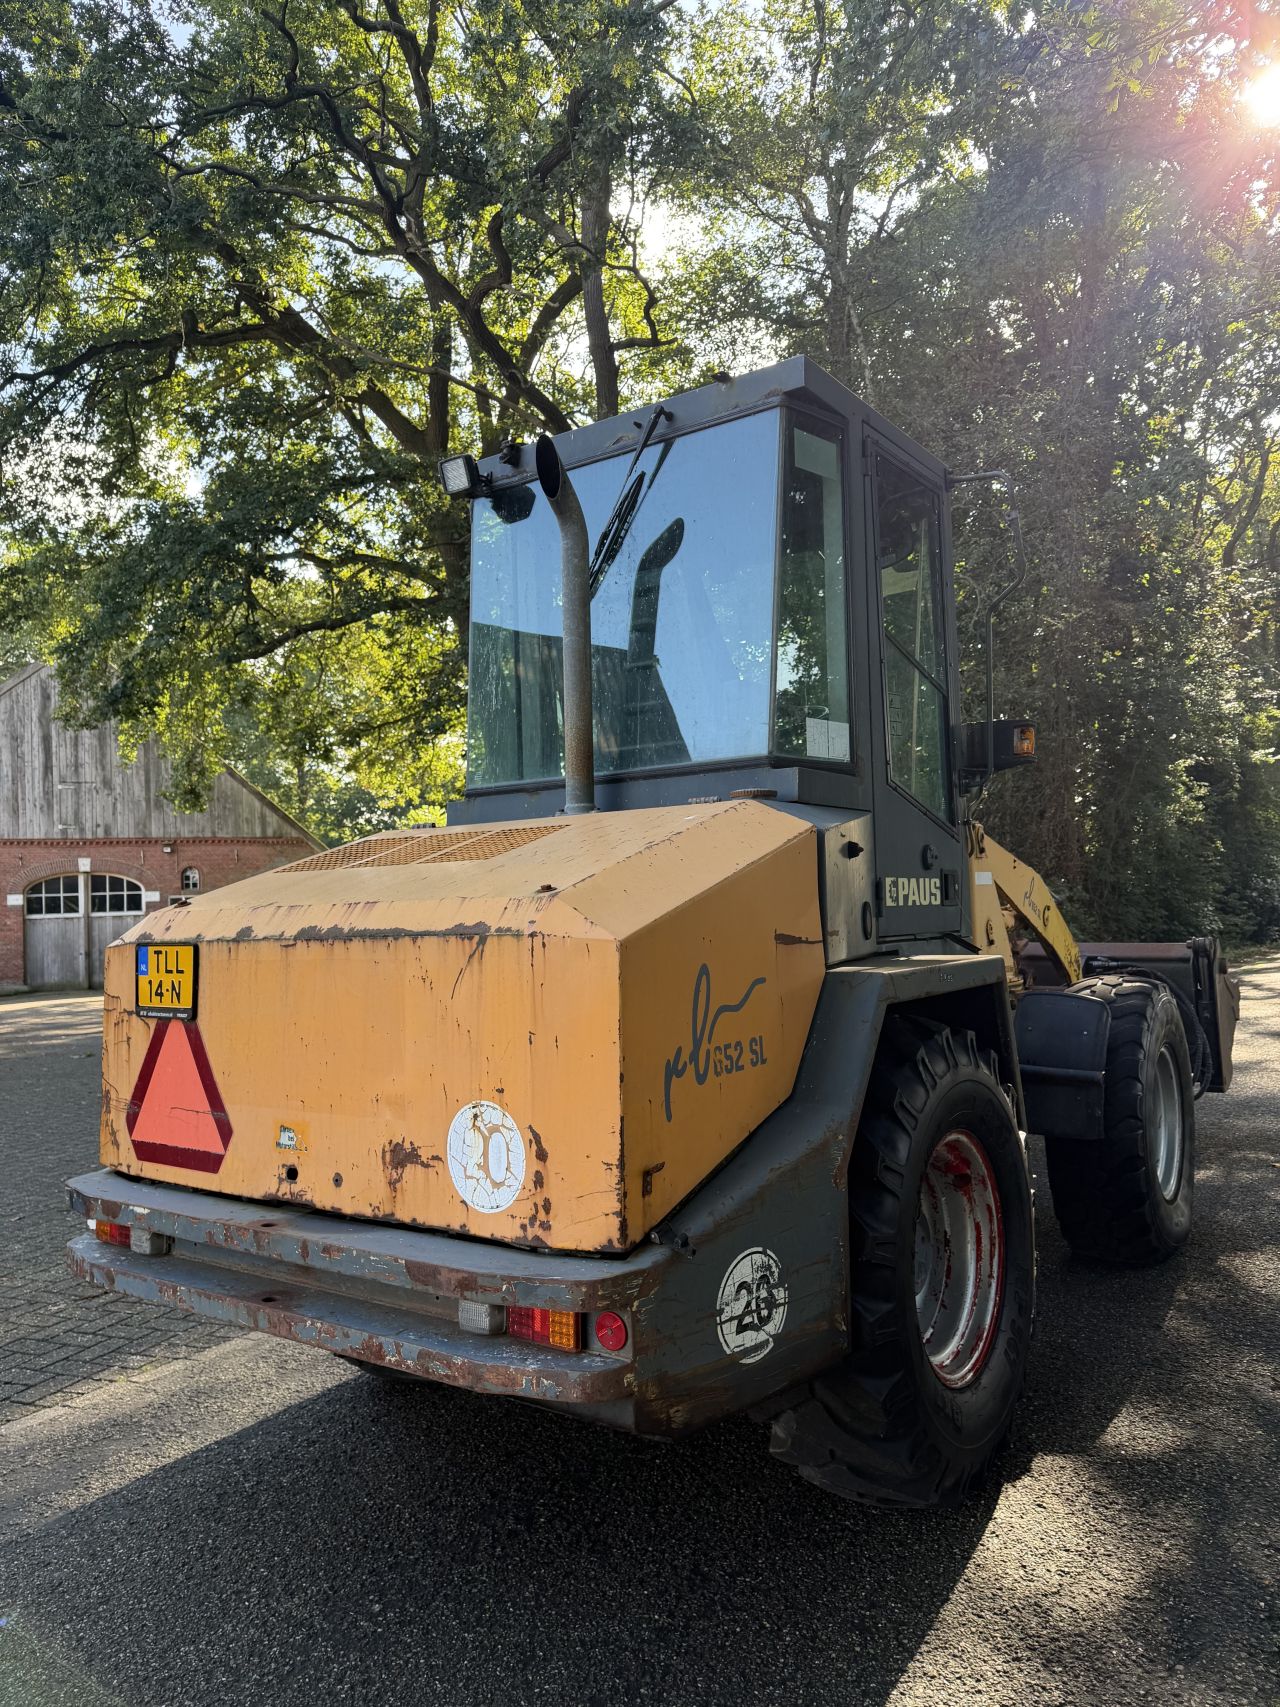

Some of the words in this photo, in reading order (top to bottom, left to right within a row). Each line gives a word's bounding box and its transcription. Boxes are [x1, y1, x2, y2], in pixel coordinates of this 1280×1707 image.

[140, 963, 147, 971] NL
[153, 950, 184, 974] TLL
[148, 979, 181, 1004] 14-N
[748, 1034, 768, 1068] SL
